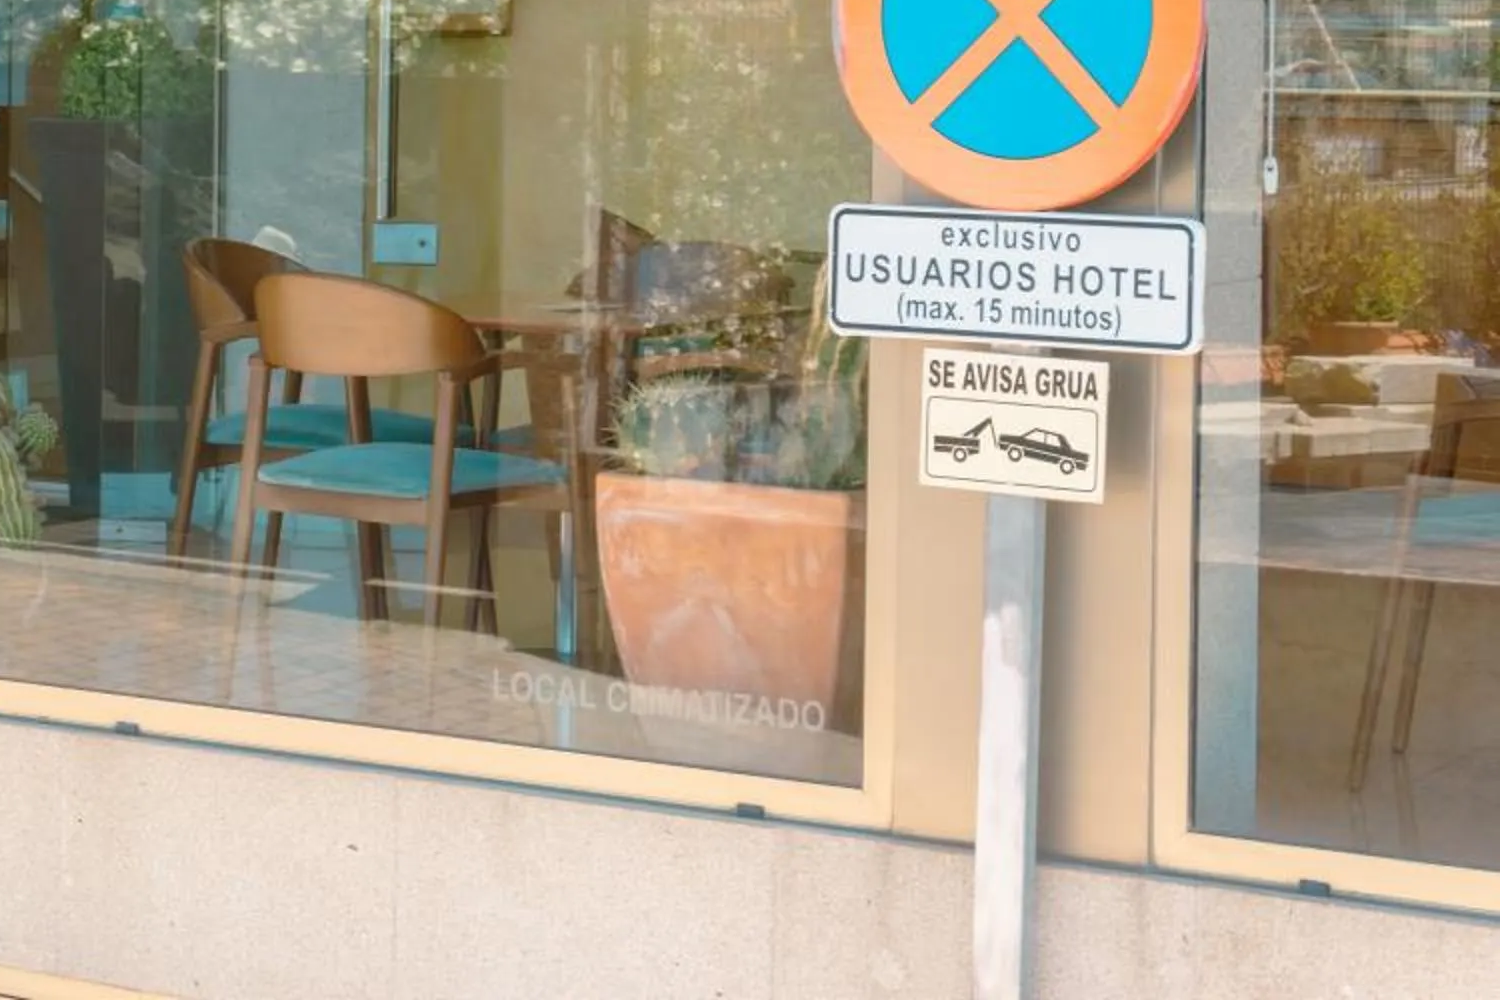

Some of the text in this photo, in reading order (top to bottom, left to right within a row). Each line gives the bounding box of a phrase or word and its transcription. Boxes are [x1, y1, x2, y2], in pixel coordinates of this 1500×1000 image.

[941, 222, 1082, 253] exclusivo
[845, 253, 1177, 301] USUARIOS HOTEL
[897, 293, 1123, 337] (max. 15 minutos)
[928, 359, 1099, 402] SE AVISA GRUA
[492, 667, 597, 708] LOCAL
